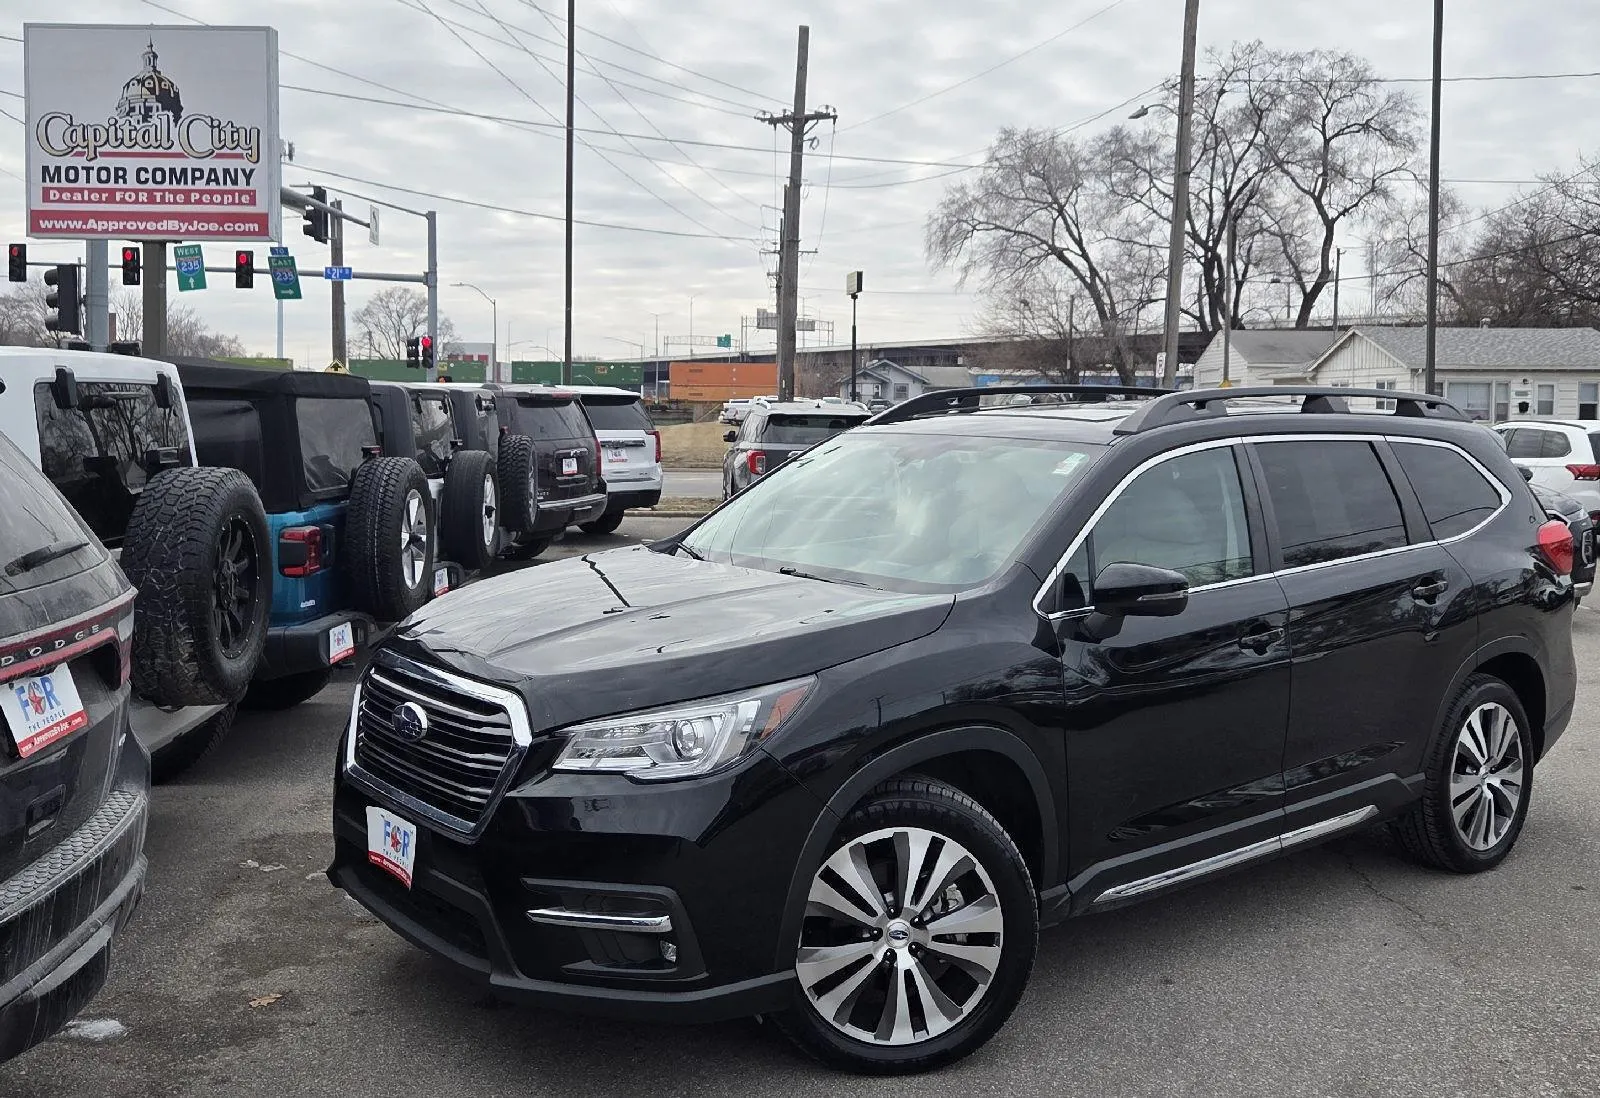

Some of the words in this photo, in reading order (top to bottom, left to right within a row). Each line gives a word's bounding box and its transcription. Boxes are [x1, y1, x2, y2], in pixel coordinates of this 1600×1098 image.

[36, 111, 174, 161] Capital
[178, 113, 260, 163] City
[41, 165, 128, 184] MOTOR
[135, 166, 256, 187] COMPANY
[49, 189, 109, 202] Dealer
[115, 191, 148, 203] FOR
[153, 191, 185, 203] The
[190, 191, 250, 205] People
[39, 218, 259, 233] www.ApprovedByJoe.com
[176, 247, 199, 256] WEST
[181, 260, 200, 272] 235
[276, 271, 294, 281] 235
[1, 624, 100, 666] DODGE
